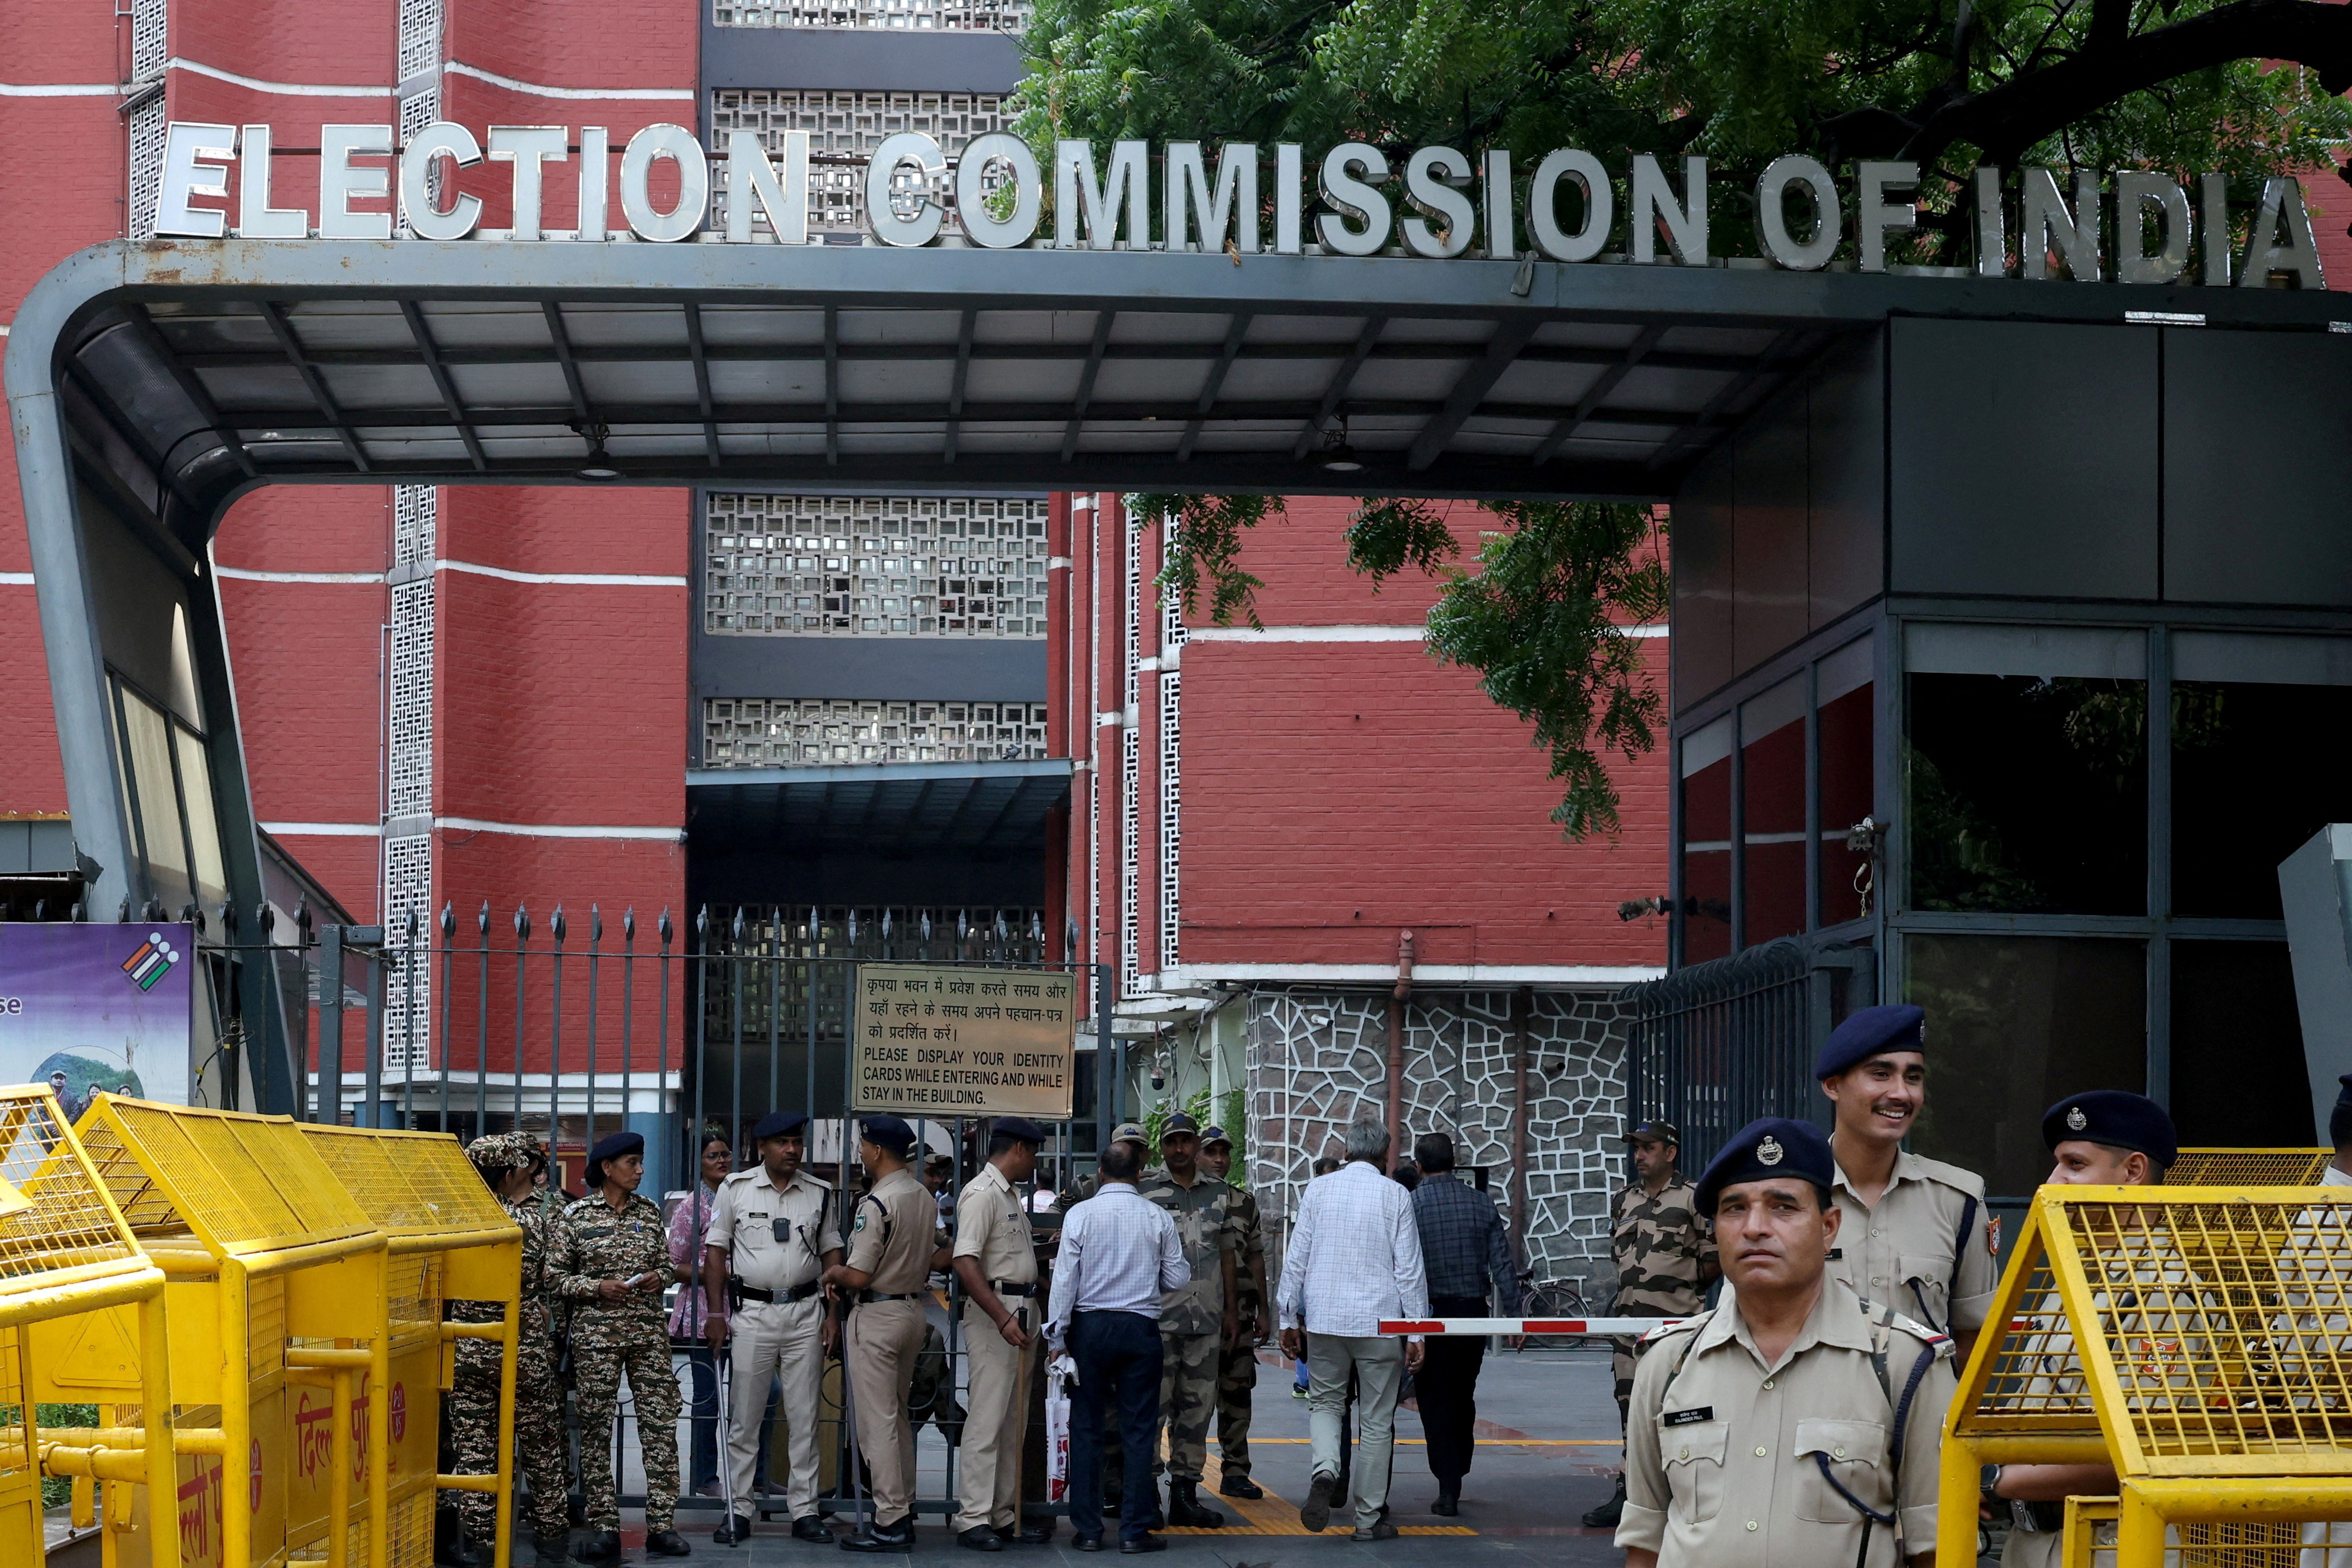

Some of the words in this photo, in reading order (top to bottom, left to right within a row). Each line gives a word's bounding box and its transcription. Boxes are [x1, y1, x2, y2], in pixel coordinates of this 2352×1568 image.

[154, 121, 810, 245] ELECTION
[864, 130, 1709, 266] COMMISSION
[1754, 153, 1920, 273] OF
[1975, 166, 2327, 290] INDIA
[868, 979, 897, 995] कृपया
[903, 980, 928, 993] भवन
[934, 976, 943, 993] में
[949, 977, 975, 994] प्रवेश
[981, 979, 1007, 996] करते
[1013, 985, 1040, 997] समय
[1046, 982, 1067, 998] और
[869, 998, 888, 1016] यहाँ
[895, 999, 917, 1017] रहने
[924, 1000, 935, 1016] के
[942, 1006, 968, 1018] समय
[975, 1003, 1000, 1019] अपने
[869, 1021, 883, 1038] को
[865, 1047, 908, 1062] PLEASE
[918, 1049, 964, 1064] DISPLAY
[973, 1052, 1004, 1066] YOUR
[1014, 1053, 1063, 1068] IDENTITY
[864, 1067, 901, 1081] CARDS
[905, 1068, 939, 1082] WHILE
[943, 1070, 998, 1085] ENTERING
[1001, 1072, 1024, 1086] AND
[1028, 1073, 1062, 1087] WHILE
[863, 1086, 889, 1100] STAY
[893, 1088, 903, 1101] IN
[906, 1088, 928, 1101] THE
[931, 1089, 985, 1104] BUILDING.
